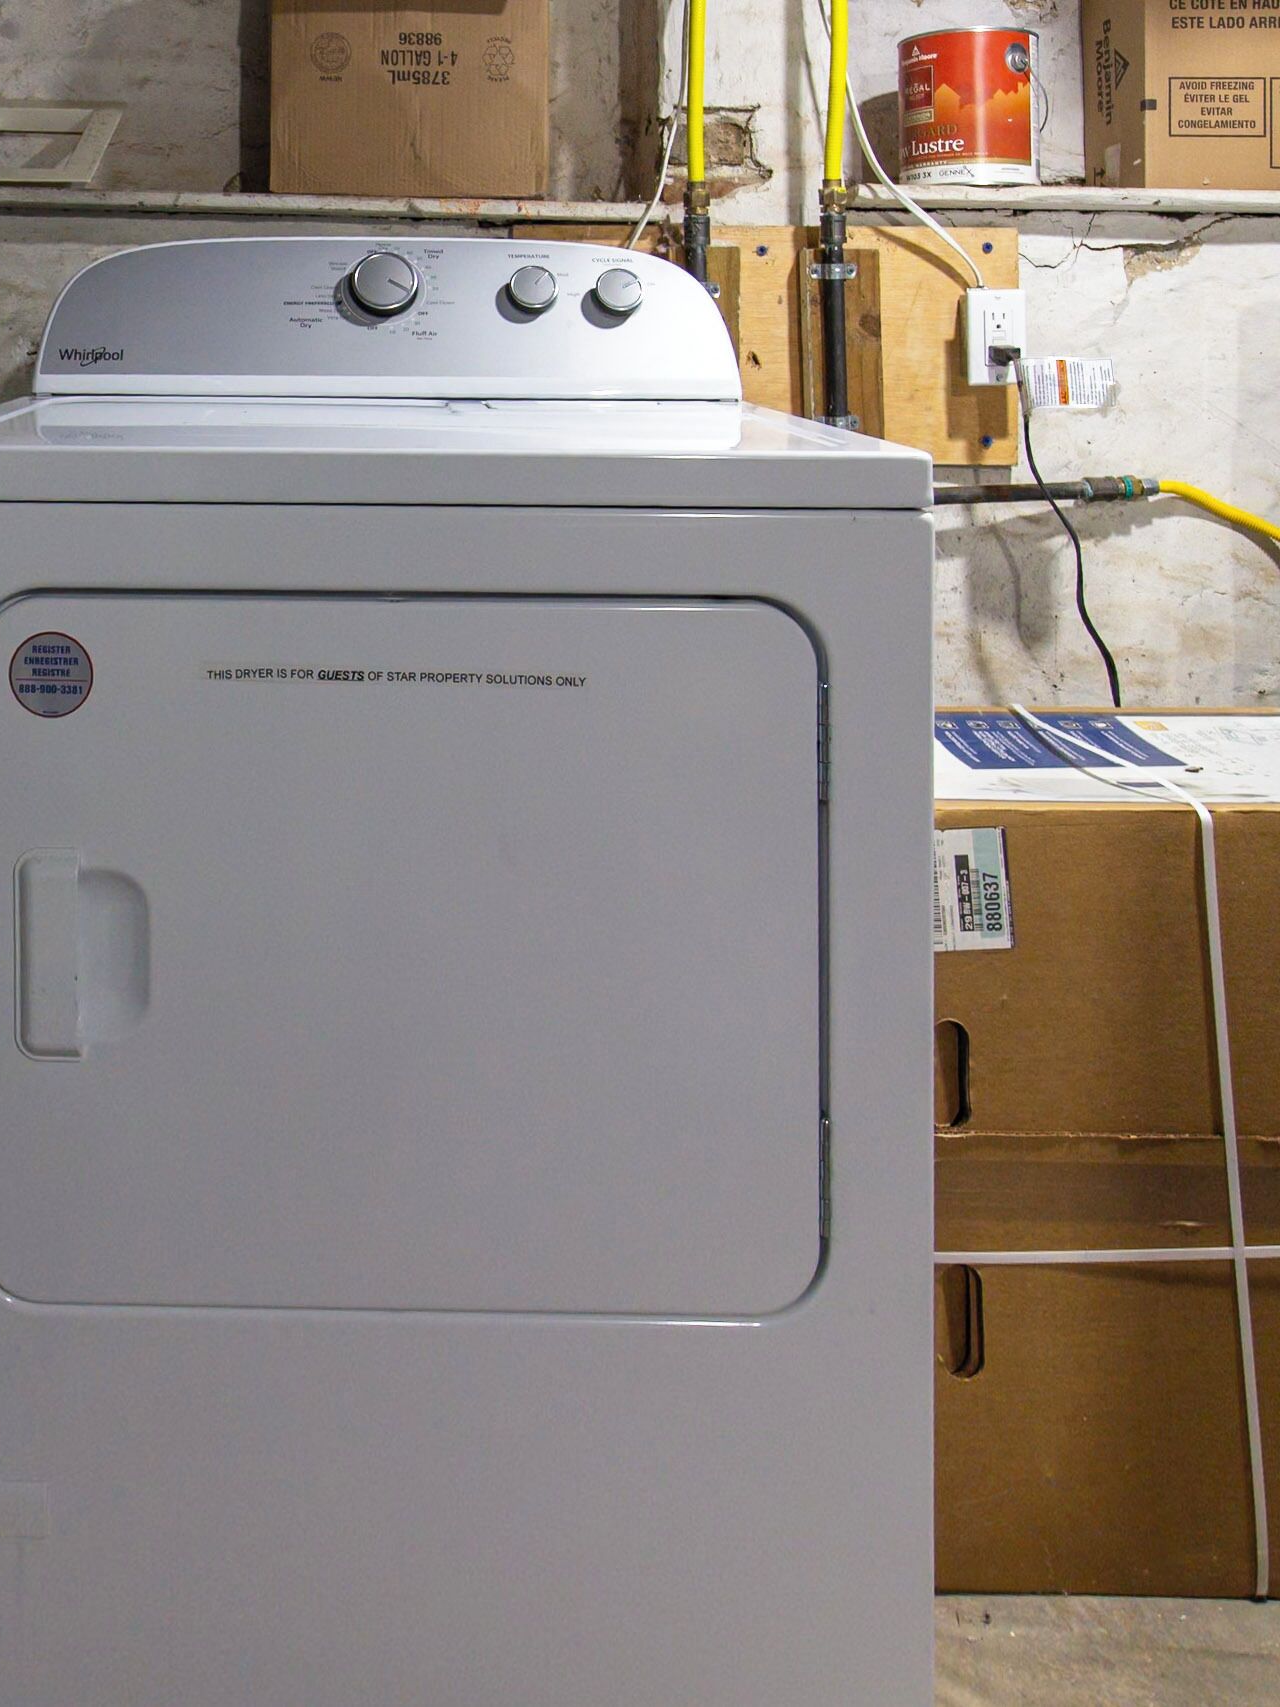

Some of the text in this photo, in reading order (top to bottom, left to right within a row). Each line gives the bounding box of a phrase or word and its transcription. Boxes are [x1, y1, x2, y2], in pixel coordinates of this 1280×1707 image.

[1230, 0, 1248, 10] EN
[1171, 16, 1205, 29] ESTE
[1209, 16, 1245, 29] LADO
[398, 32, 442, 47] 98836
[380, 50, 431, 67] GALLON
[387, 70, 451, 85] 3785mL
[1094, 40, 1104, 113] Moore
[1102, 18, 1114, 126] Benjamin
[1179, 81, 1255, 91] AVOID FREEZING
[1183, 92, 1250, 103] ÉVITER LE GEL
[1200, 107, 1233, 116] EVITAR
[1178, 119, 1256, 129] CONGELAMIENTO
[911, 138, 965, 155] Lustre
[58, 347, 124, 366] Whirlpool
[31, 645, 71, 654] REGISTER
[24, 656, 79, 666] ENREGISTRER
[207, 668, 587, 688] THIS DRYER IS FOR GUESTS OF STAR PROPERTY SOLUTIONS ONLY
[18, 684, 83, 695] 888-900-3381
[982, 872, 1003, 932] 880637
